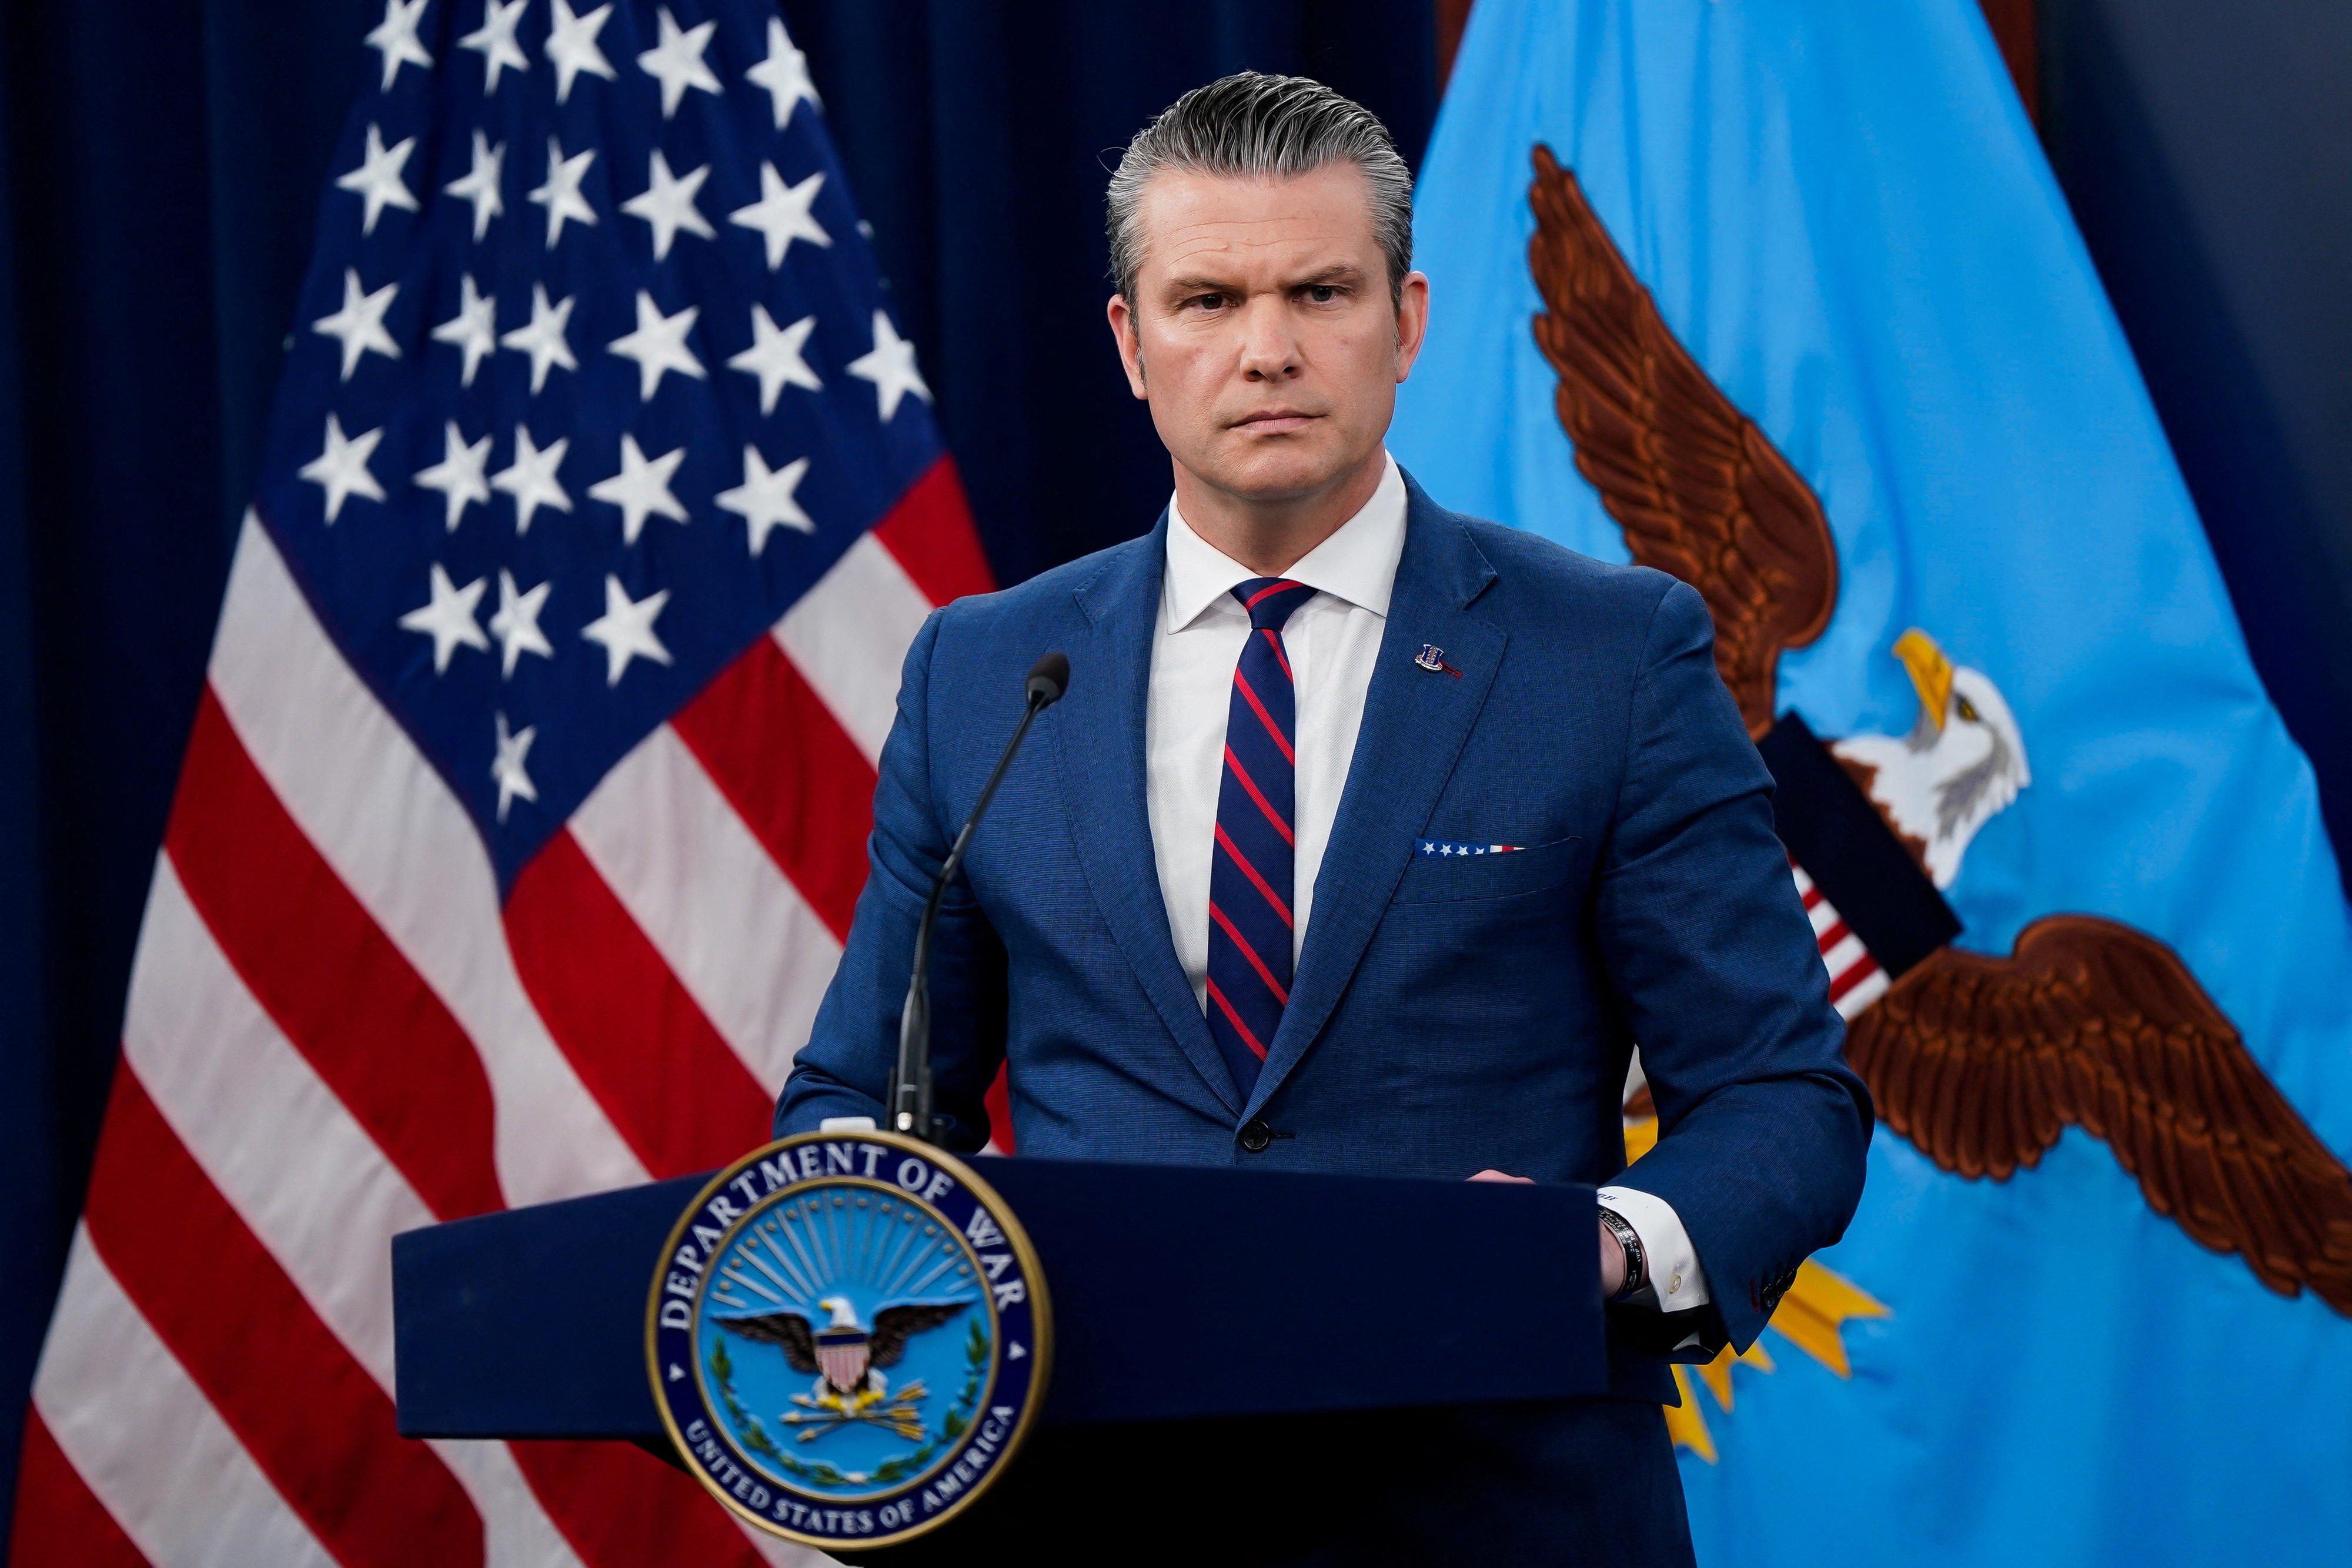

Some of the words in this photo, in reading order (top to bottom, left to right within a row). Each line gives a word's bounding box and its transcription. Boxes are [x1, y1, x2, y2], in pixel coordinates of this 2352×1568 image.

[661, 1142, 888, 1330] DEPARTMENT
[897, 1158, 954, 1203] OF
[965, 1205, 1026, 1312] WAR
[686, 1419, 770, 1510] UNITED
[772, 1499, 874, 1534] STATES
[880, 1497, 914, 1528] OF
[922, 1406, 1014, 1512] AMERICA
